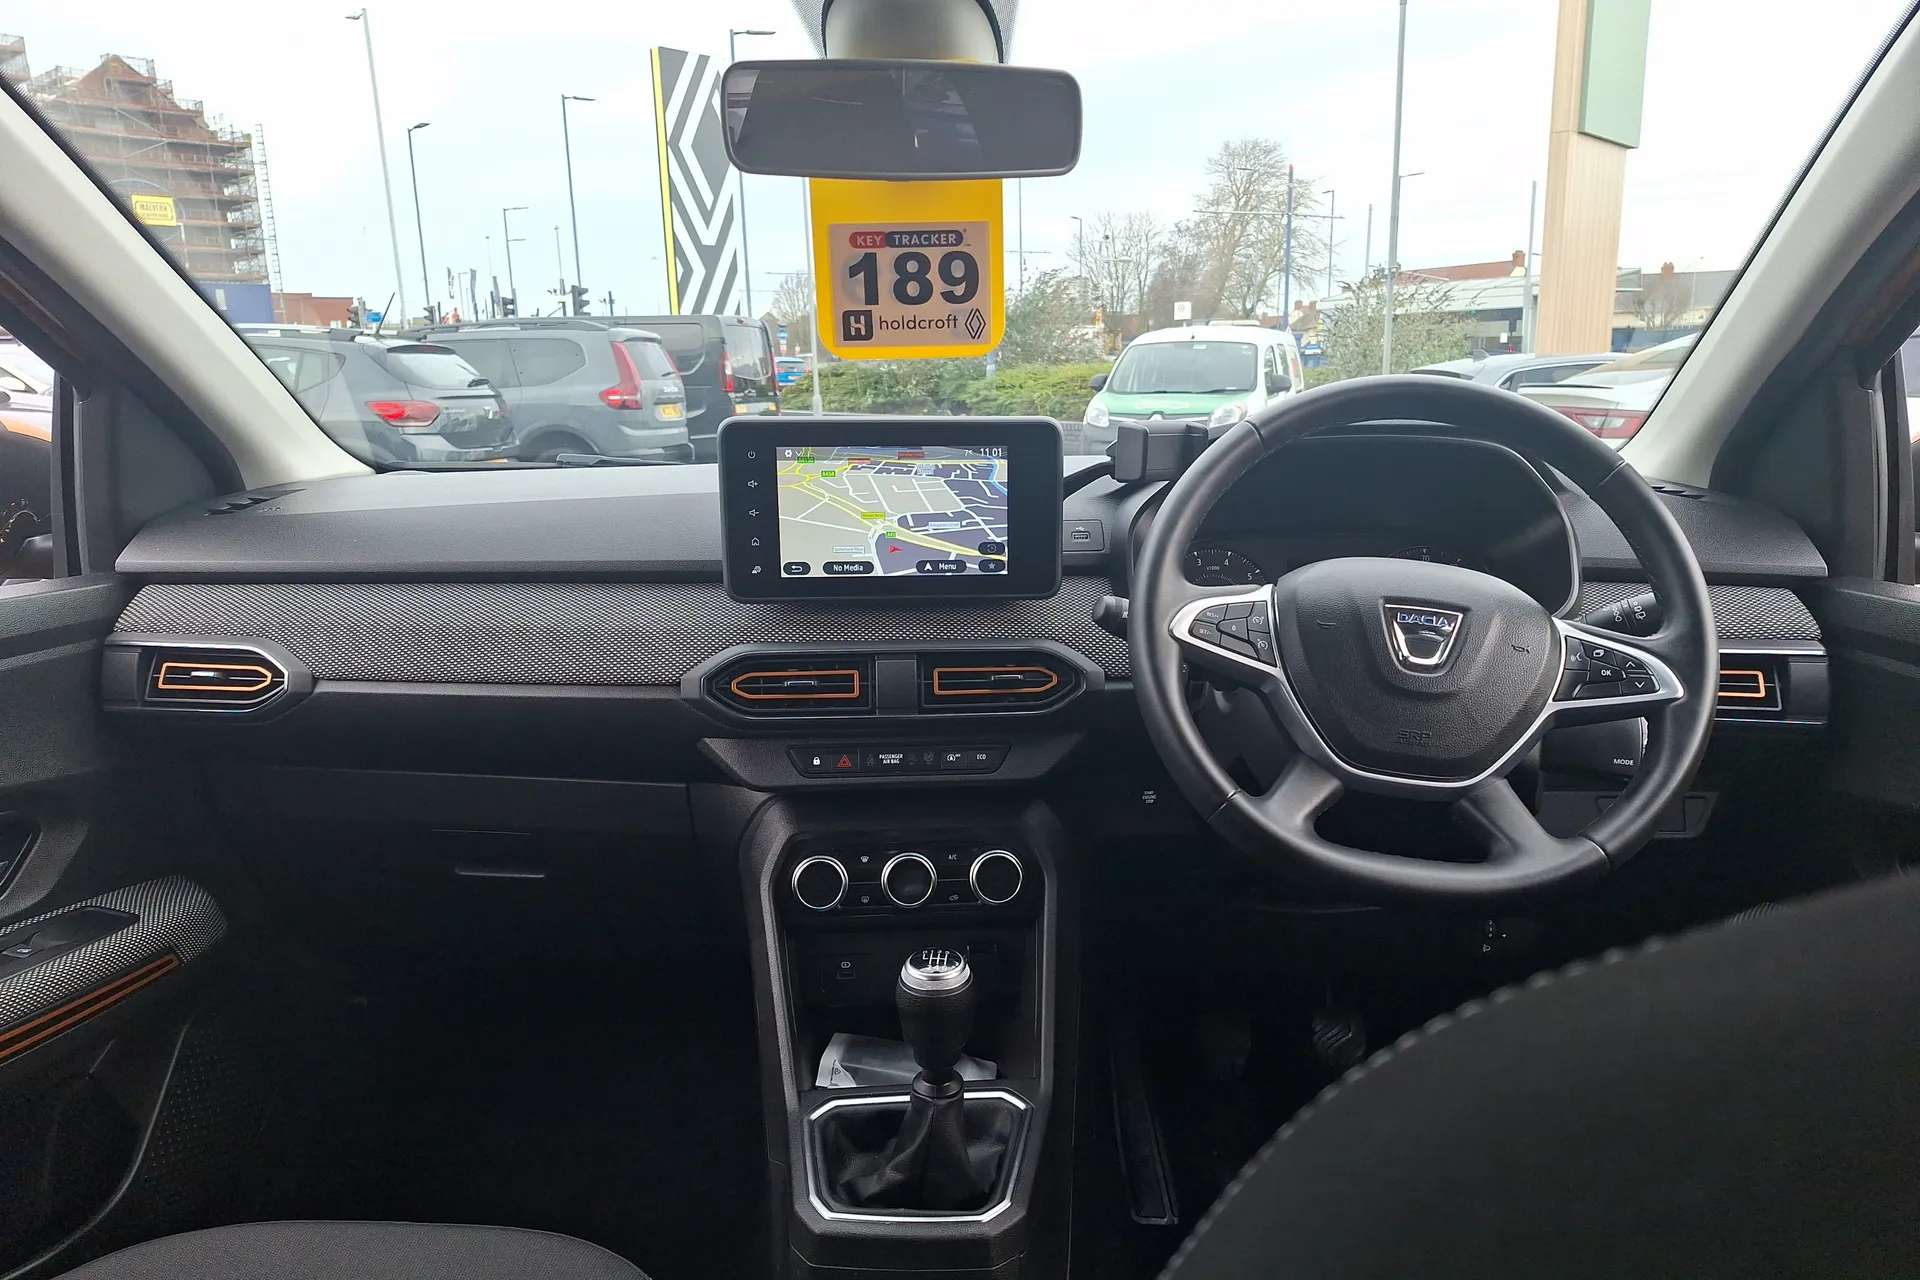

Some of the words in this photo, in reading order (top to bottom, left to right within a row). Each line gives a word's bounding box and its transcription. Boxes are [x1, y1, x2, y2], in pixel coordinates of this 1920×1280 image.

[856, 235, 882, 246] KEY
[893, 233, 956, 245] TRACKER
[848, 251, 979, 305] 189
[879, 313, 958, 330] holdcroft
[939, 562, 957, 570] Menu
[1197, 558, 1202, 566] 3
[833, 564, 843, 572] No
[844, 563, 864, 572] Media
[1247, 572, 1252, 580] 5
[1396, 612, 1449, 628] DACIA
[1613, 758, 1634, 766] MODE
